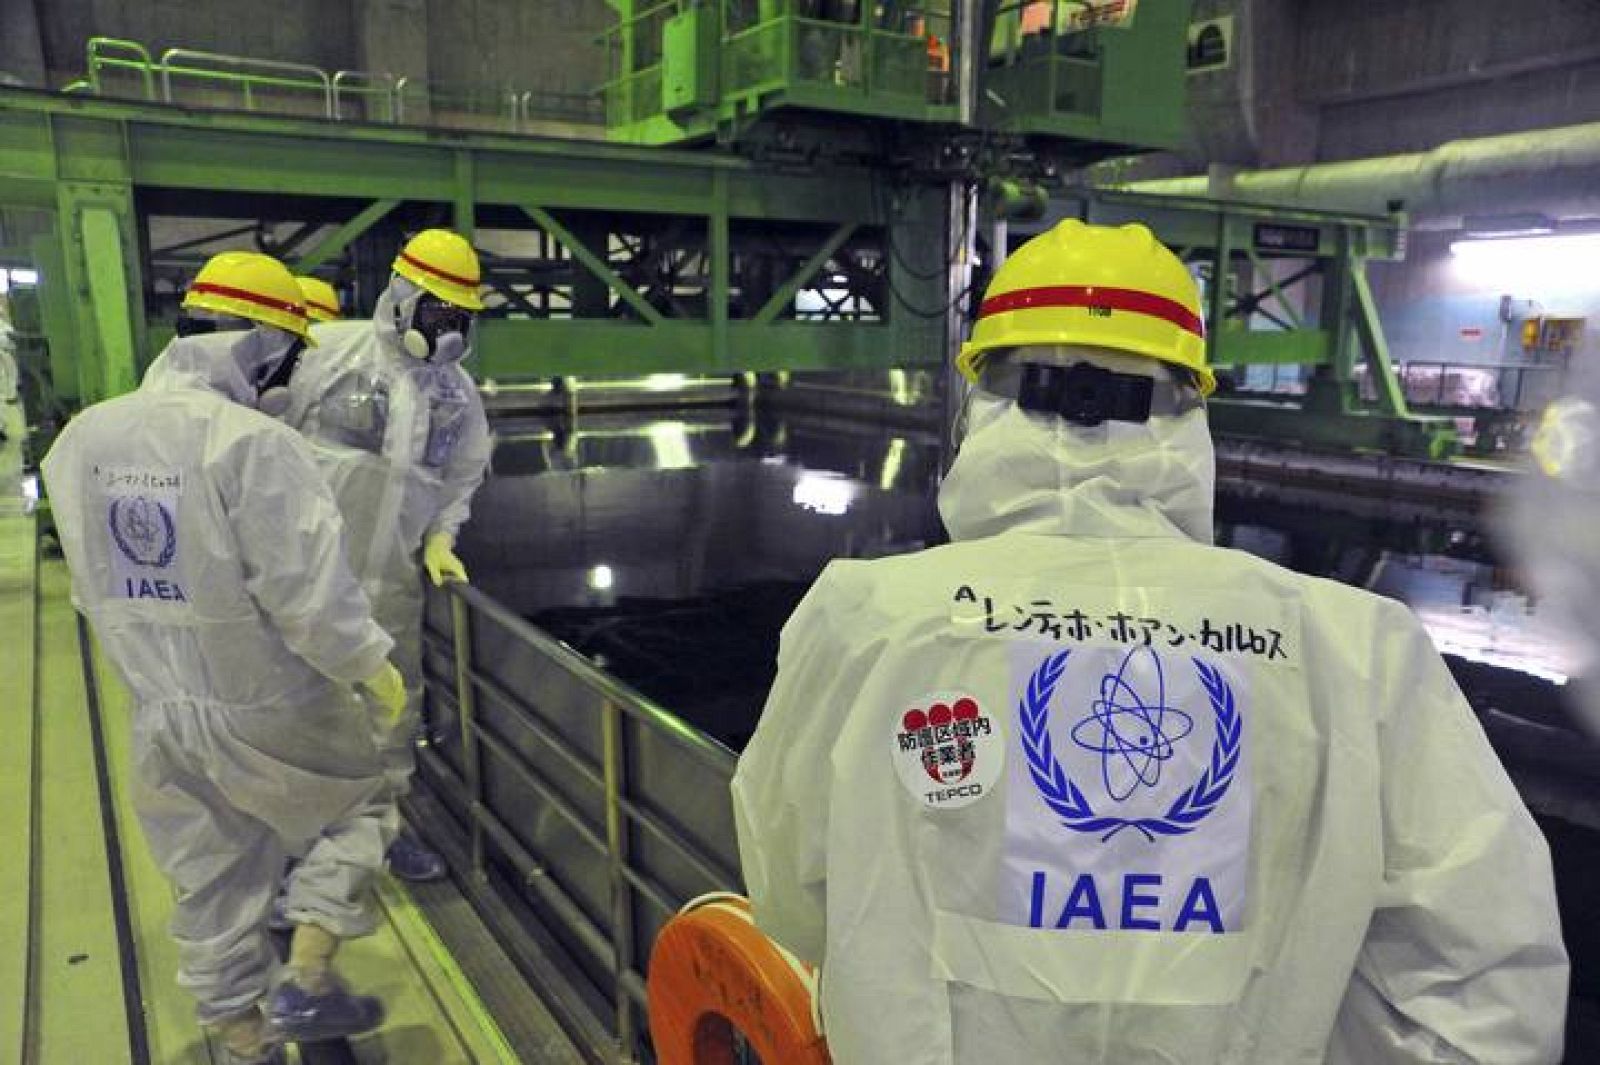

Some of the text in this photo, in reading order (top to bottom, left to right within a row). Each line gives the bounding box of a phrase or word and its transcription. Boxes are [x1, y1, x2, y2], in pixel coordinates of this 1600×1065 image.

[126, 578, 186, 602] IAEA
[954, 585, 976, 602] A
[924, 784, 983, 804] TEPCO
[1029, 871, 1225, 934] IAEA
